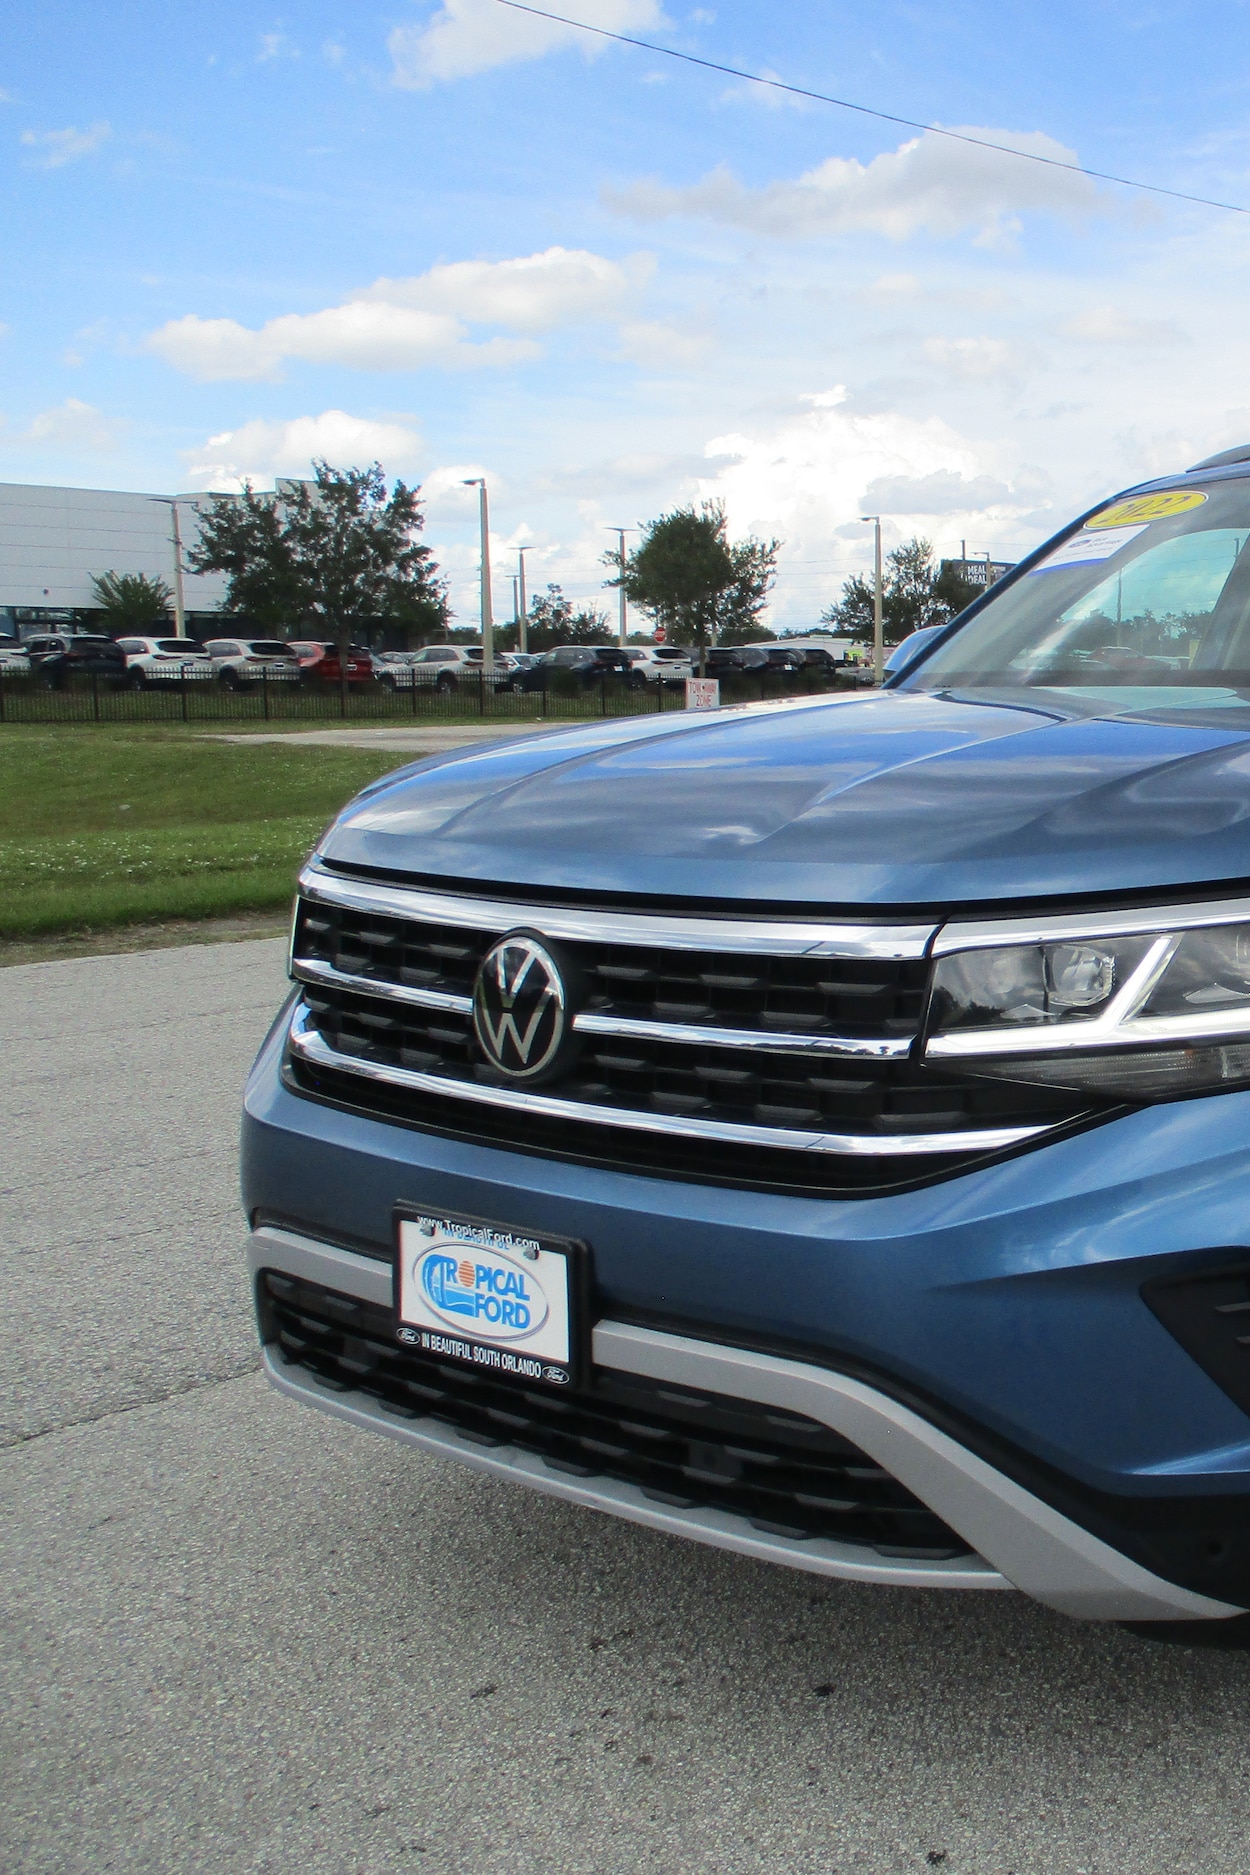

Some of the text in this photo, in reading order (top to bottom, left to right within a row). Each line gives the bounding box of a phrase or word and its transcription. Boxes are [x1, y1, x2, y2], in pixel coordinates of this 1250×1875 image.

[967, 565, 987, 575] MEAL
[417, 1216, 541, 1251] www.TropicalFord.com
[474, 1294, 531, 1329] FORD
[421, 1332, 430, 1349] IN
[431, 1334, 473, 1361] BEAUTIFUL
[473, 1345, 501, 1368] SOUTH
[501, 1353, 542, 1379] ORLANDO
